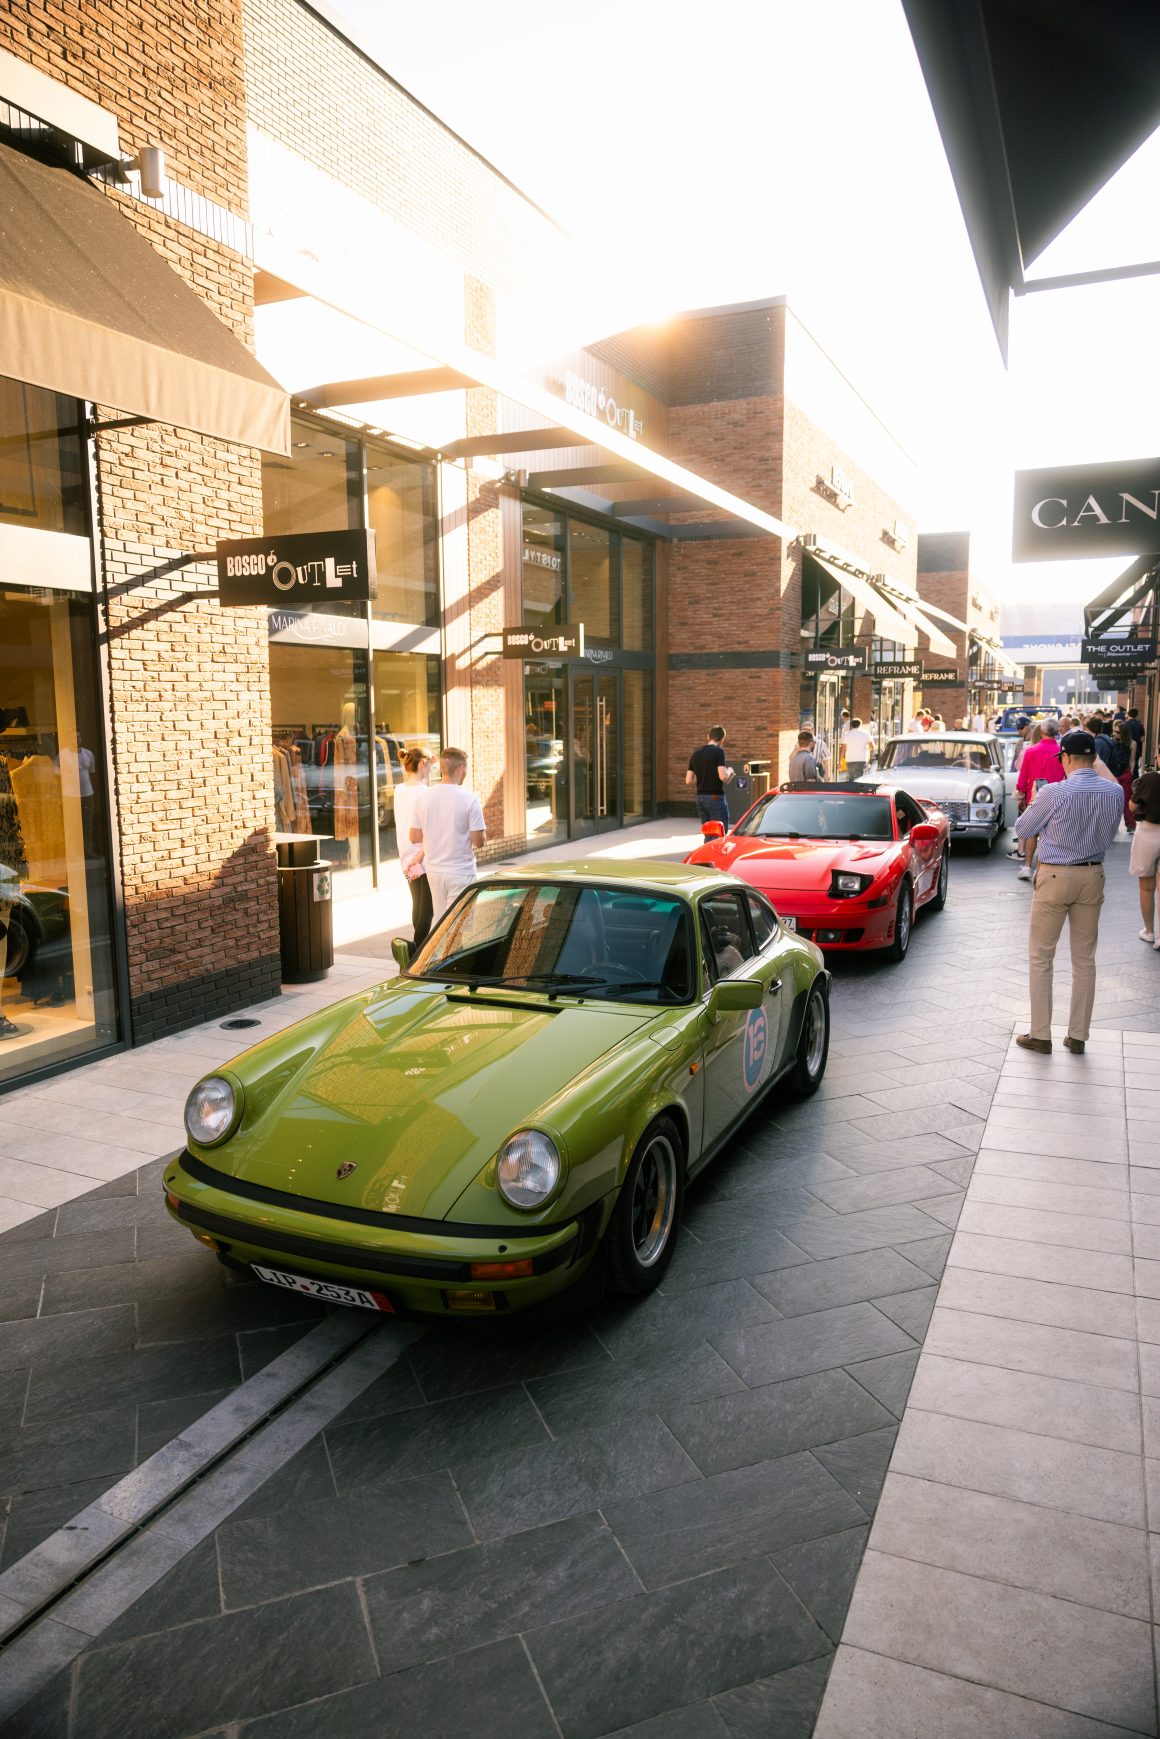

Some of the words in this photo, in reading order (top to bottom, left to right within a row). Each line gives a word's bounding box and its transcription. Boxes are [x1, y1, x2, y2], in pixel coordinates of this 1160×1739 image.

[226, 553, 266, 577] BOSCO
[1109, 644, 1151, 652] OUTLET
[876, 665, 920, 675] REFRAME
[254, 1267, 297, 1288] LIP
[310, 1280, 375, 1308] 253A
